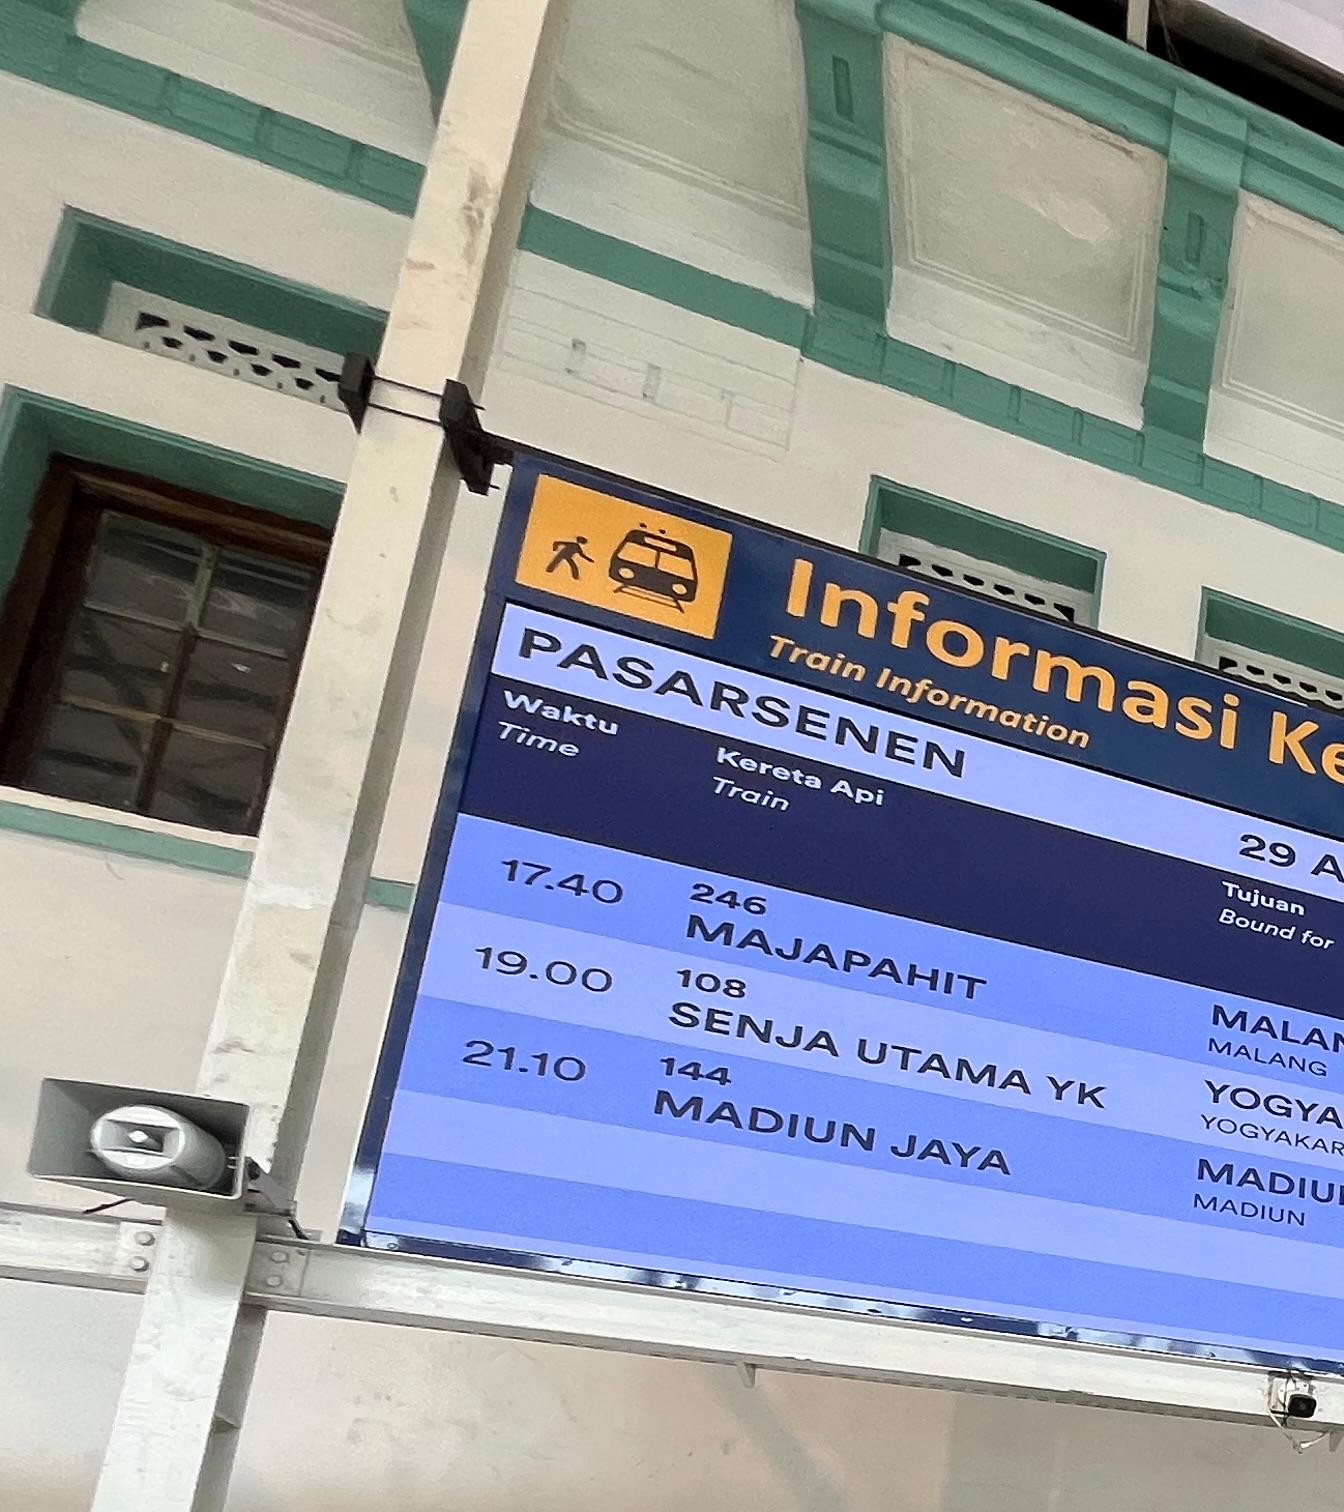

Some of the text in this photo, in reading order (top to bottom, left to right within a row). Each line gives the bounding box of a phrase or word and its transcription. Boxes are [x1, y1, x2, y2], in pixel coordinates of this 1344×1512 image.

[785, 558, 1238, 750] Informasi
[503, 690, 620, 736] Waktu
[518, 628, 966, 779] PASARSENEN
[768, 634, 1091, 749] Train Information
[497, 721, 580, 759] Time
[711, 776, 790, 812] Train
[716, 747, 884, 806] Kereta Api
[1238, 833, 1297, 868] 29
[501, 859, 624, 905] 17.40
[689, 881, 768, 916] 246
[1222, 880, 1306, 917] Tujuan
[1218, 908, 1335, 952] Bound for
[474, 946, 614, 994] 19.00
[685, 914, 988, 1001] MAJAPAHIT
[675, 968, 747, 999] 108
[462, 1039, 587, 1082] 21.10
[659, 1055, 732, 1086] 144
[669, 1001, 1107, 1110] SENJA UTAMA YK
[1207, 1036, 1328, 1077] MALANG
[653, 1089, 1011, 1177] MADIUN JAYA
[1192, 1193, 1306, 1227] MADIUN
